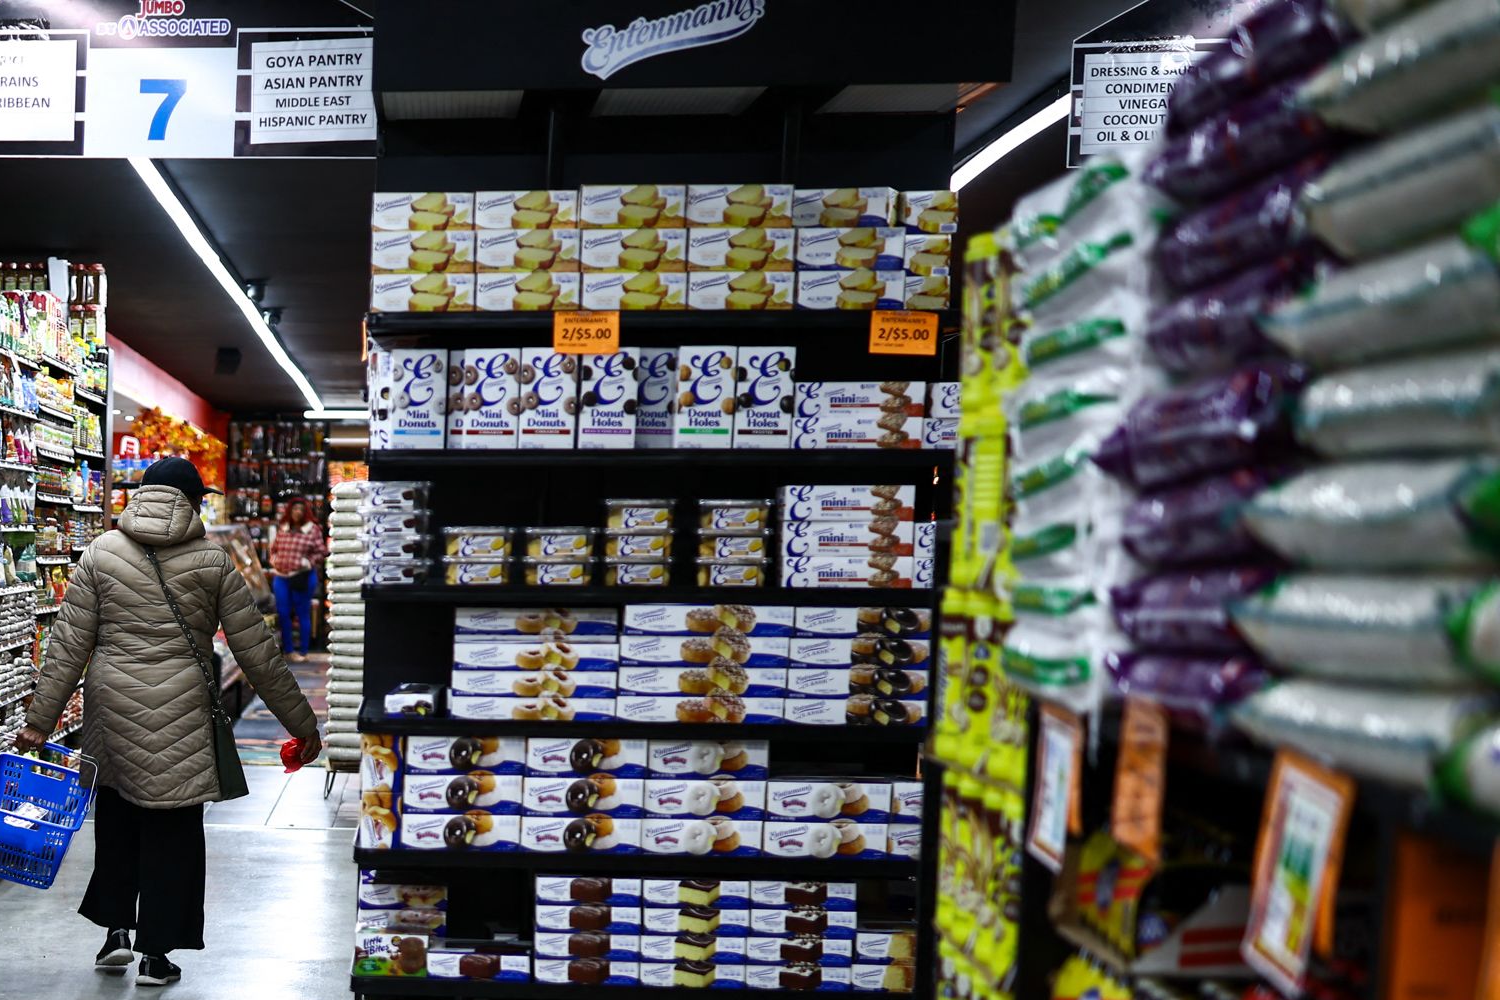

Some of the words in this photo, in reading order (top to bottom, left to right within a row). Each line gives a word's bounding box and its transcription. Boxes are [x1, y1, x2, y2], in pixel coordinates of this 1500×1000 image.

[138, 0, 184, 18] JUMBO
[140, 19, 231, 36] ASSOCIATED
[266, 55, 305, 68] GOYA
[308, 53, 363, 67] PANTRY
[1091, 66, 1148, 77] DRESSING
[1150, 66, 1160, 76] &
[264, 77, 305, 90] ASIAN
[309, 74, 363, 88] PANTRY
[1105, 83, 1177, 94] CONDIMEN
[275, 96, 320, 108] MIDDLE
[323, 95, 351, 107] EAST
[1119, 98, 1168, 109] VINEGA
[140, 79, 187, 140] 7
[259, 115, 316, 127] HISPANIC
[319, 113, 367, 126] PANTRY
[1103, 115, 1167, 126] COCONUT
[1097, 131, 1117, 141] OIL
[1121, 130, 1130, 141] &
[562, 328, 612, 341] 2/$5.00
[878, 328, 930, 341] 2/$5.00
[830, 394, 856, 403] mini
[406, 409, 430, 419] Mini
[479, 409, 502, 419] Mini
[535, 409, 559, 418] Mini
[591, 408, 625, 418] Donut
[688, 408, 722, 417] Donut
[746, 409, 780, 418] Donut
[398, 419, 437, 428] Donuts
[471, 419, 510, 428] Donuts
[527, 418, 566, 427] Donuts
[591, 418, 623, 427] Holes
[689, 418, 720, 427] Holes
[747, 418, 779, 427] Holes
[826, 429, 852, 438] mini
[821, 497, 847, 507] mini
[819, 533, 844, 542] mini
[818, 568, 844, 578] mini
